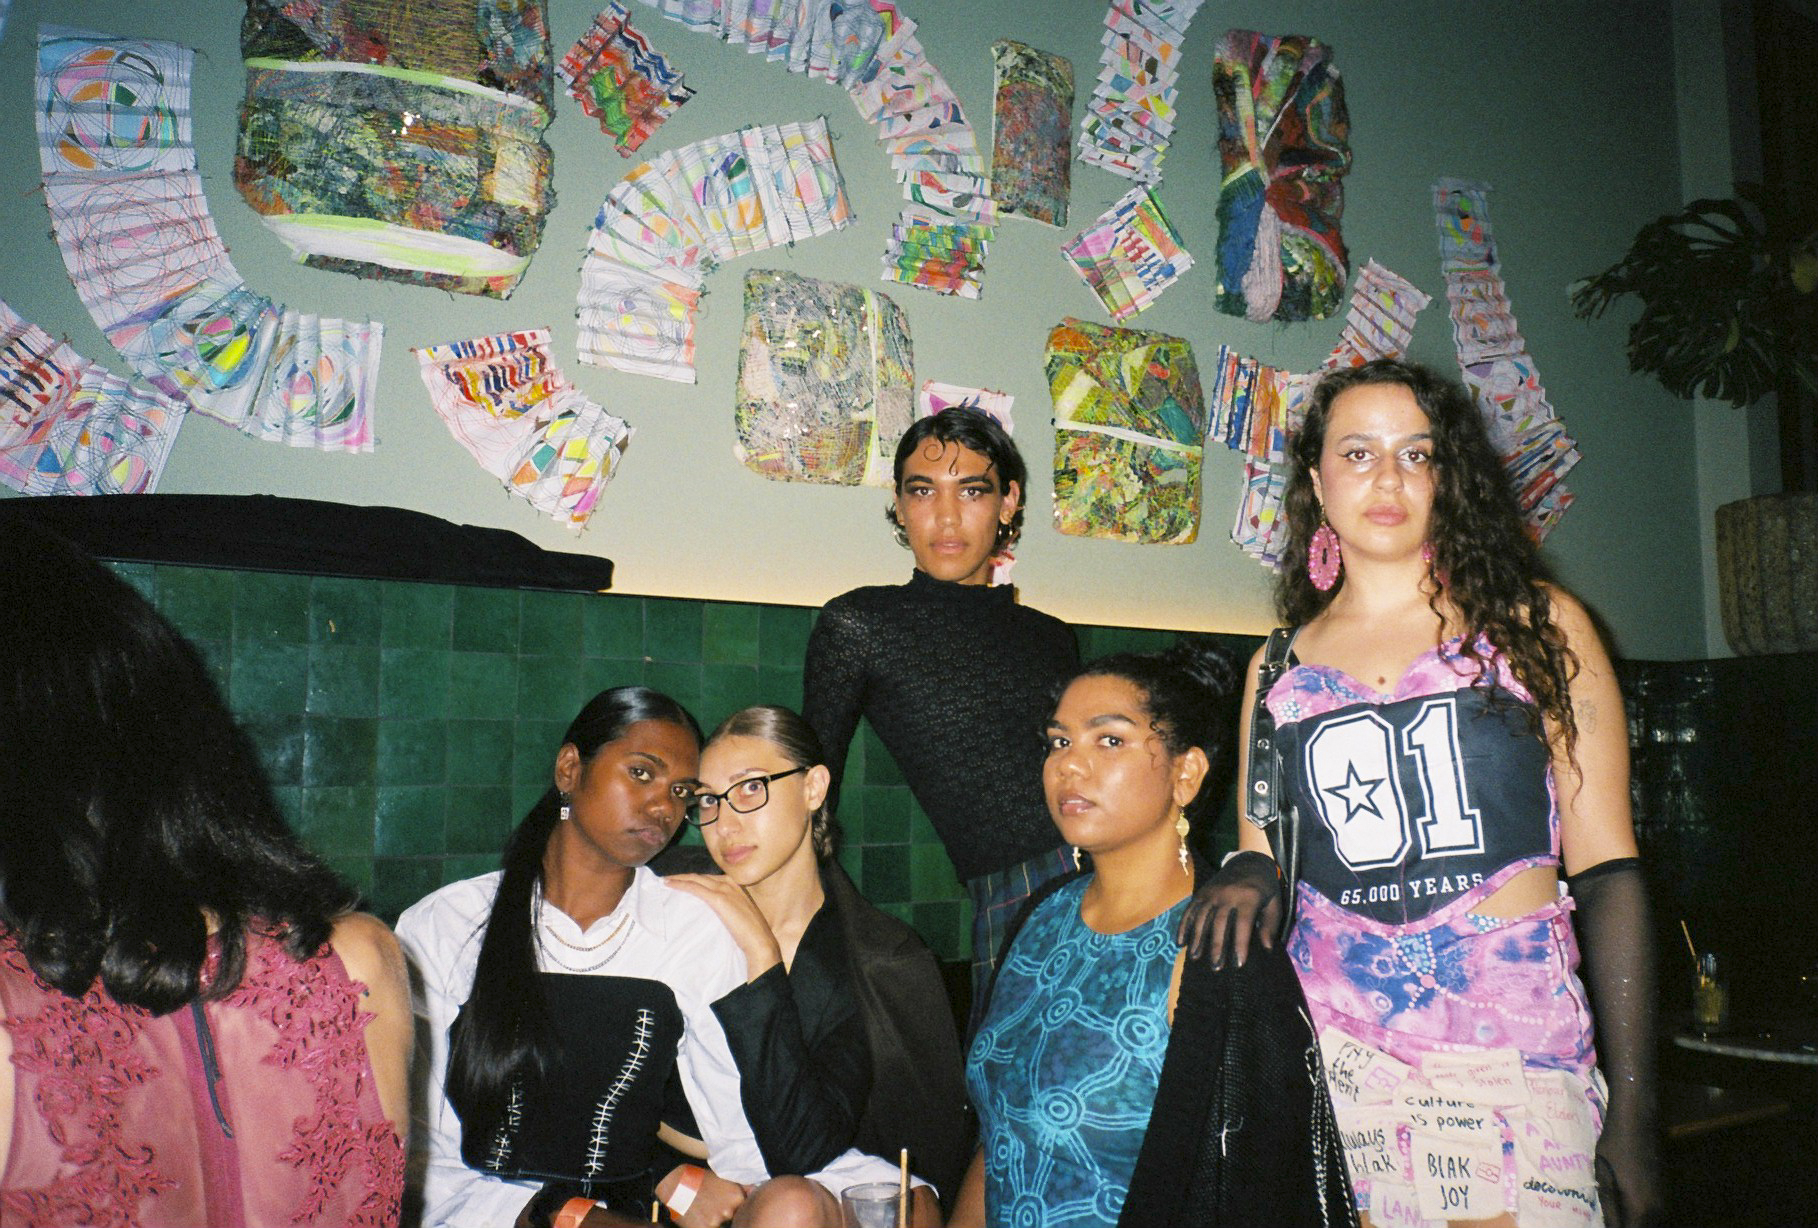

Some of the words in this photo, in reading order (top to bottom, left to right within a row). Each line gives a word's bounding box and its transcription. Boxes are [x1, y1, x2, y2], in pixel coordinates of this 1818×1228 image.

[1305, 697, 1485, 871] 01
[1340, 884, 1400, 905] 65.000
[1408, 872, 1484, 898] YEARS
[1436, 1116, 1484, 1132] power
[1440, 1184, 1469, 1210] JOY
